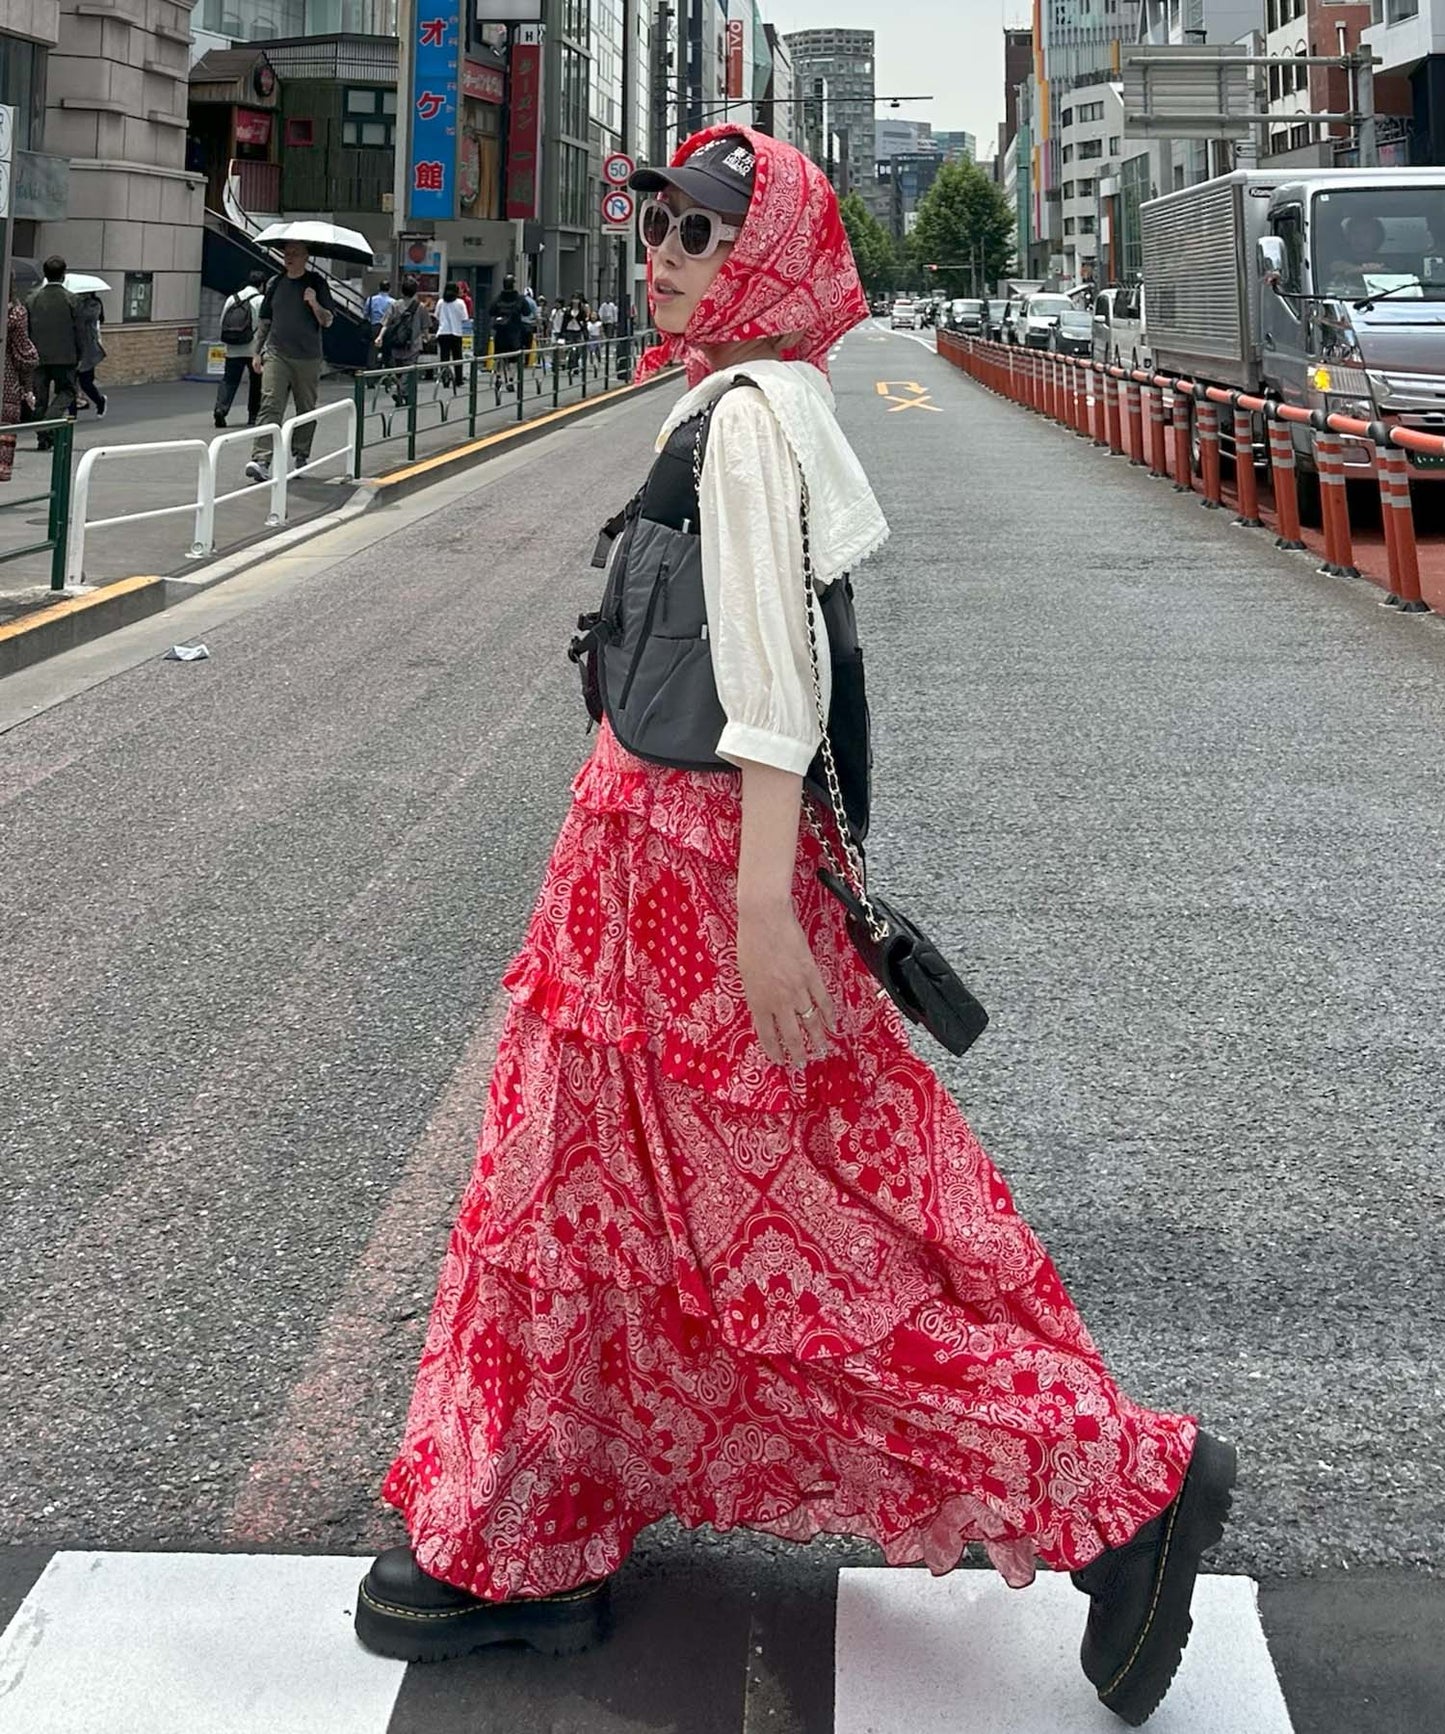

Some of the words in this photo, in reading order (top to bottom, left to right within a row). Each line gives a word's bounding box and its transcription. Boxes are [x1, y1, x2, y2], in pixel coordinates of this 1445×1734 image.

[415, 18, 447, 191] オケ館
[610, 163, 628, 177] 50
